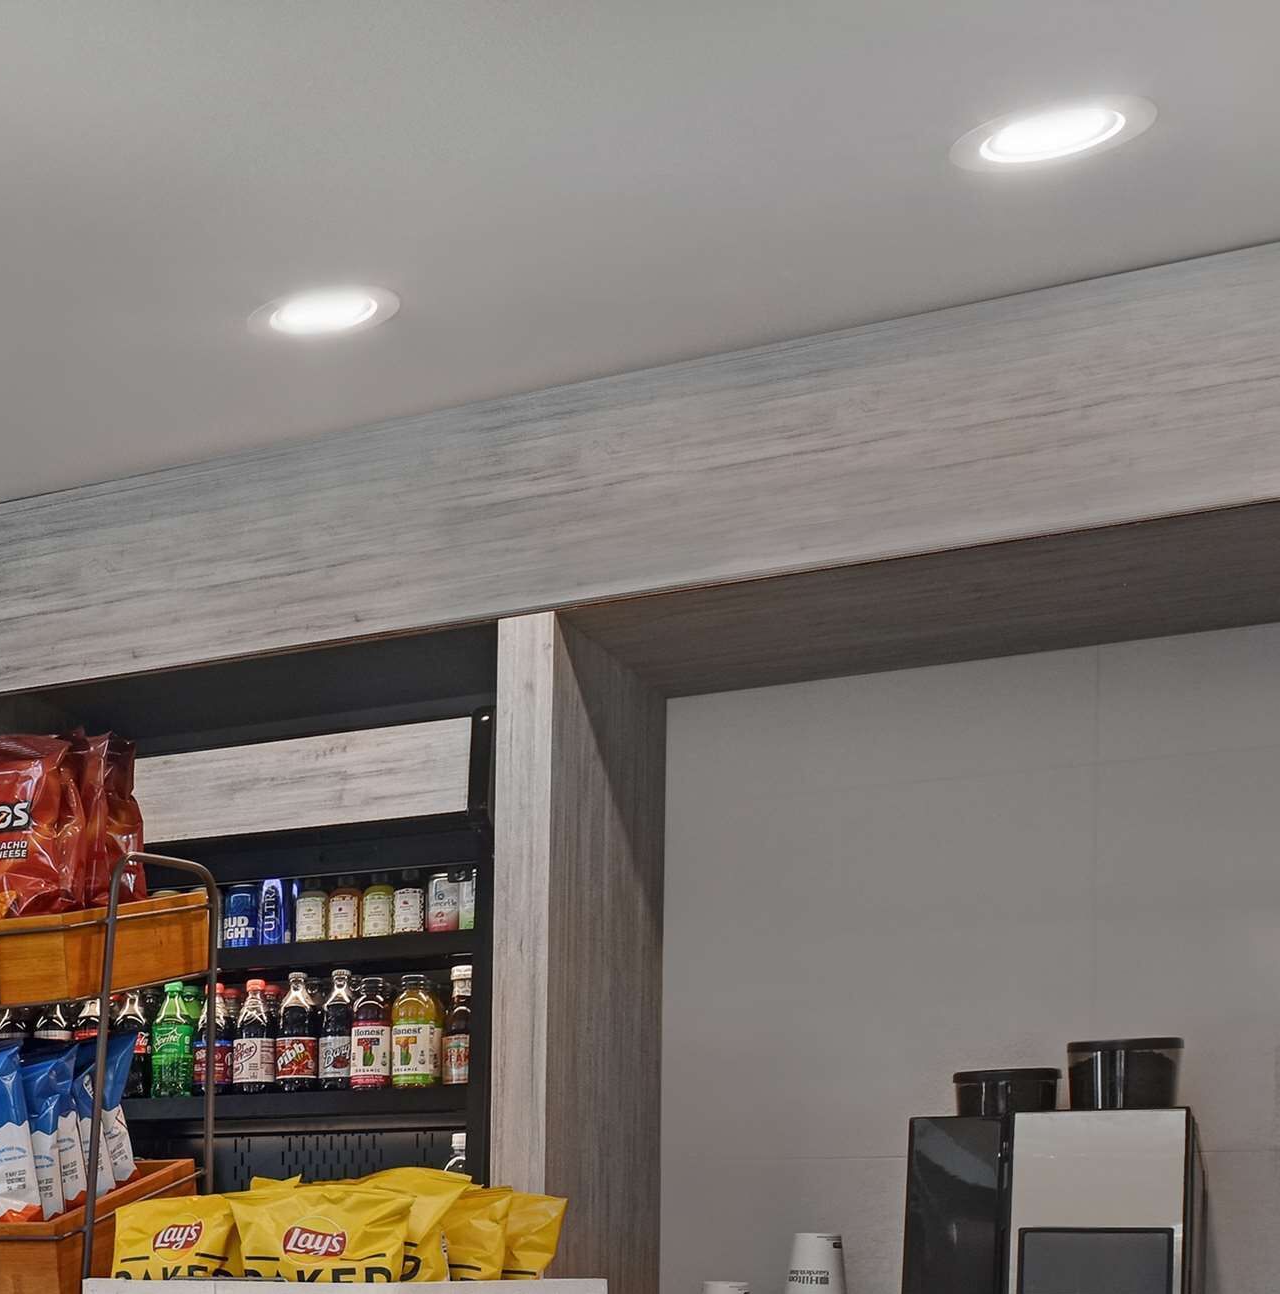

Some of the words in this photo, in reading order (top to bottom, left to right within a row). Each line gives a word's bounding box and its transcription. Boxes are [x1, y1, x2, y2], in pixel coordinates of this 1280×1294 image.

[262, 884, 277, 932] ULTRA
[224, 915, 249, 931] BUD
[223, 928, 256, 942] IGHT
[154, 1031, 181, 1048] Sprite
[353, 1028, 385, 1038] Honest
[277, 1042, 306, 1073] Pibb
[324, 1044, 350, 1069] Barq
[154, 1220, 201, 1250] Lay's
[286, 1228, 345, 1257] Lay's
[114, 1265, 230, 1281] AKE
[788, 1276, 820, 1285] Hilton
